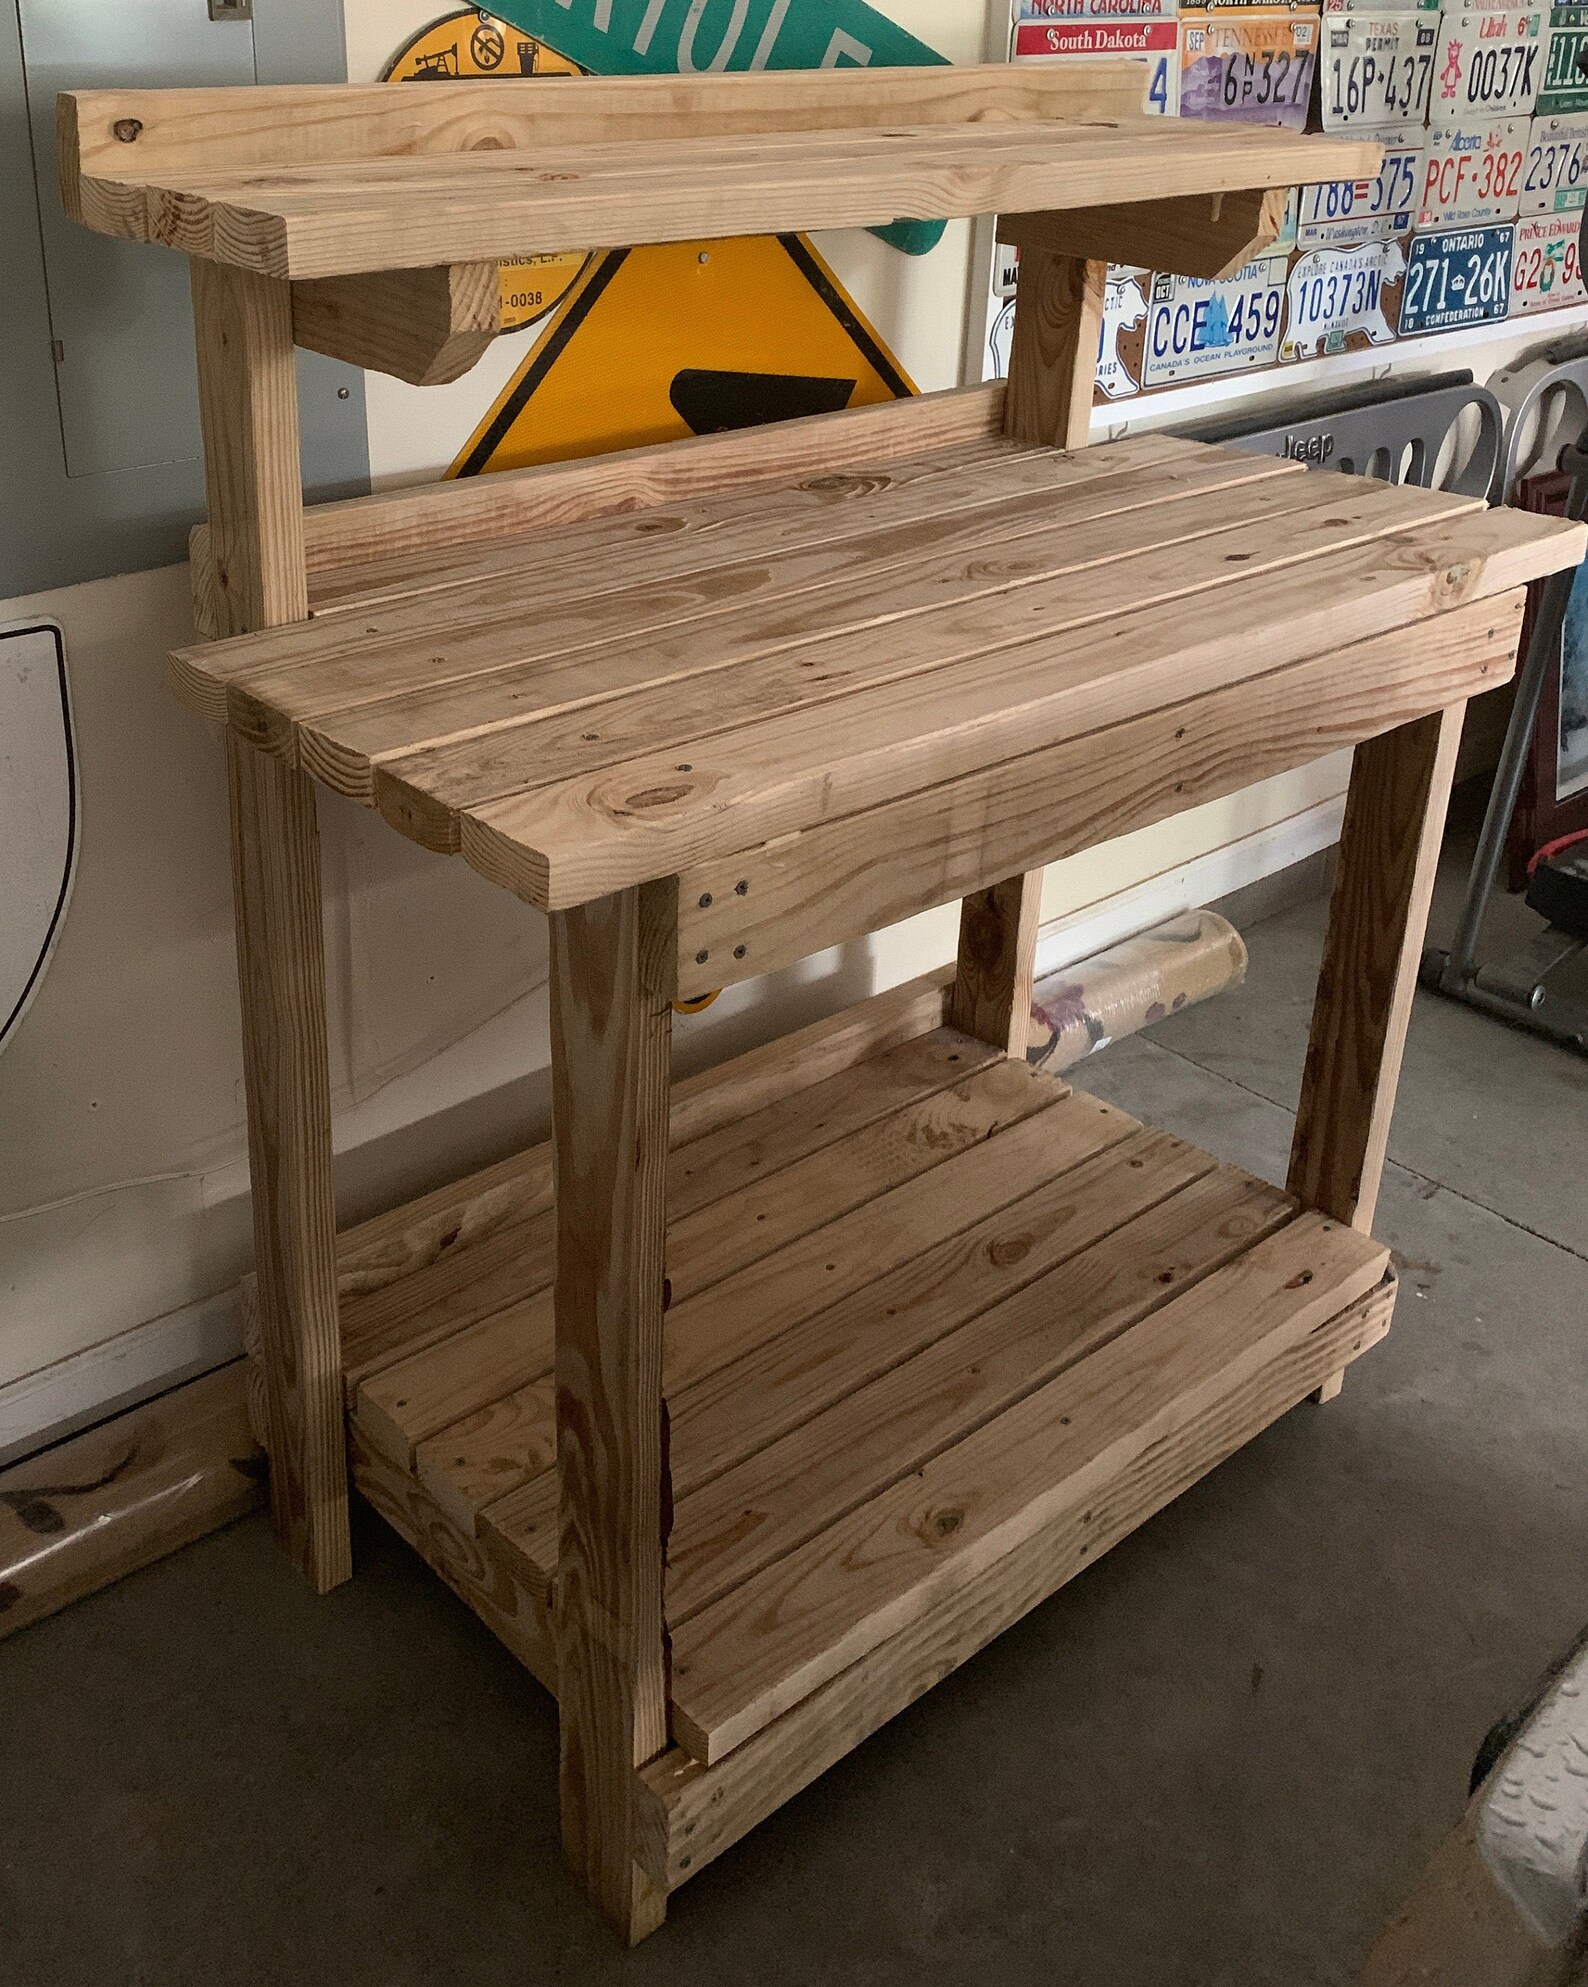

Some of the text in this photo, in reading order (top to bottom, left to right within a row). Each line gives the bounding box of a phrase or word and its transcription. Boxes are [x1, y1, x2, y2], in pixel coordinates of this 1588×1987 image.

[1031, 0, 1084, 15] NORTH
[1368, 22, 1399, 37] TEXAS
[1479, 14, 1507, 39] Utah
[1050, 29, 1147, 51] South Dakota
[1189, 31, 1205, 51] SEP
[1467, 45, 1539, 103] 0037K
[1415, 231, 1510, 256] 19 ONTARIO 67
[1404, 250, 1509, 315] 271 26K
[1104, 295, 1123, 311] CTIC
[1298, 269, 1382, 325] 10373N
[1228, 290, 1280, 344] 459
[1404, 303, 1504, 329] 18 CONFEDERATION 67
[1096, 362, 1117, 378] RIES
[1150, 357, 1190, 372] CANADA'S
[1193, 353, 1221, 364] OCEAN
[1223, 343, 1274, 358] PLAYGROUND
[1276, 433, 1334, 464] Jeep
